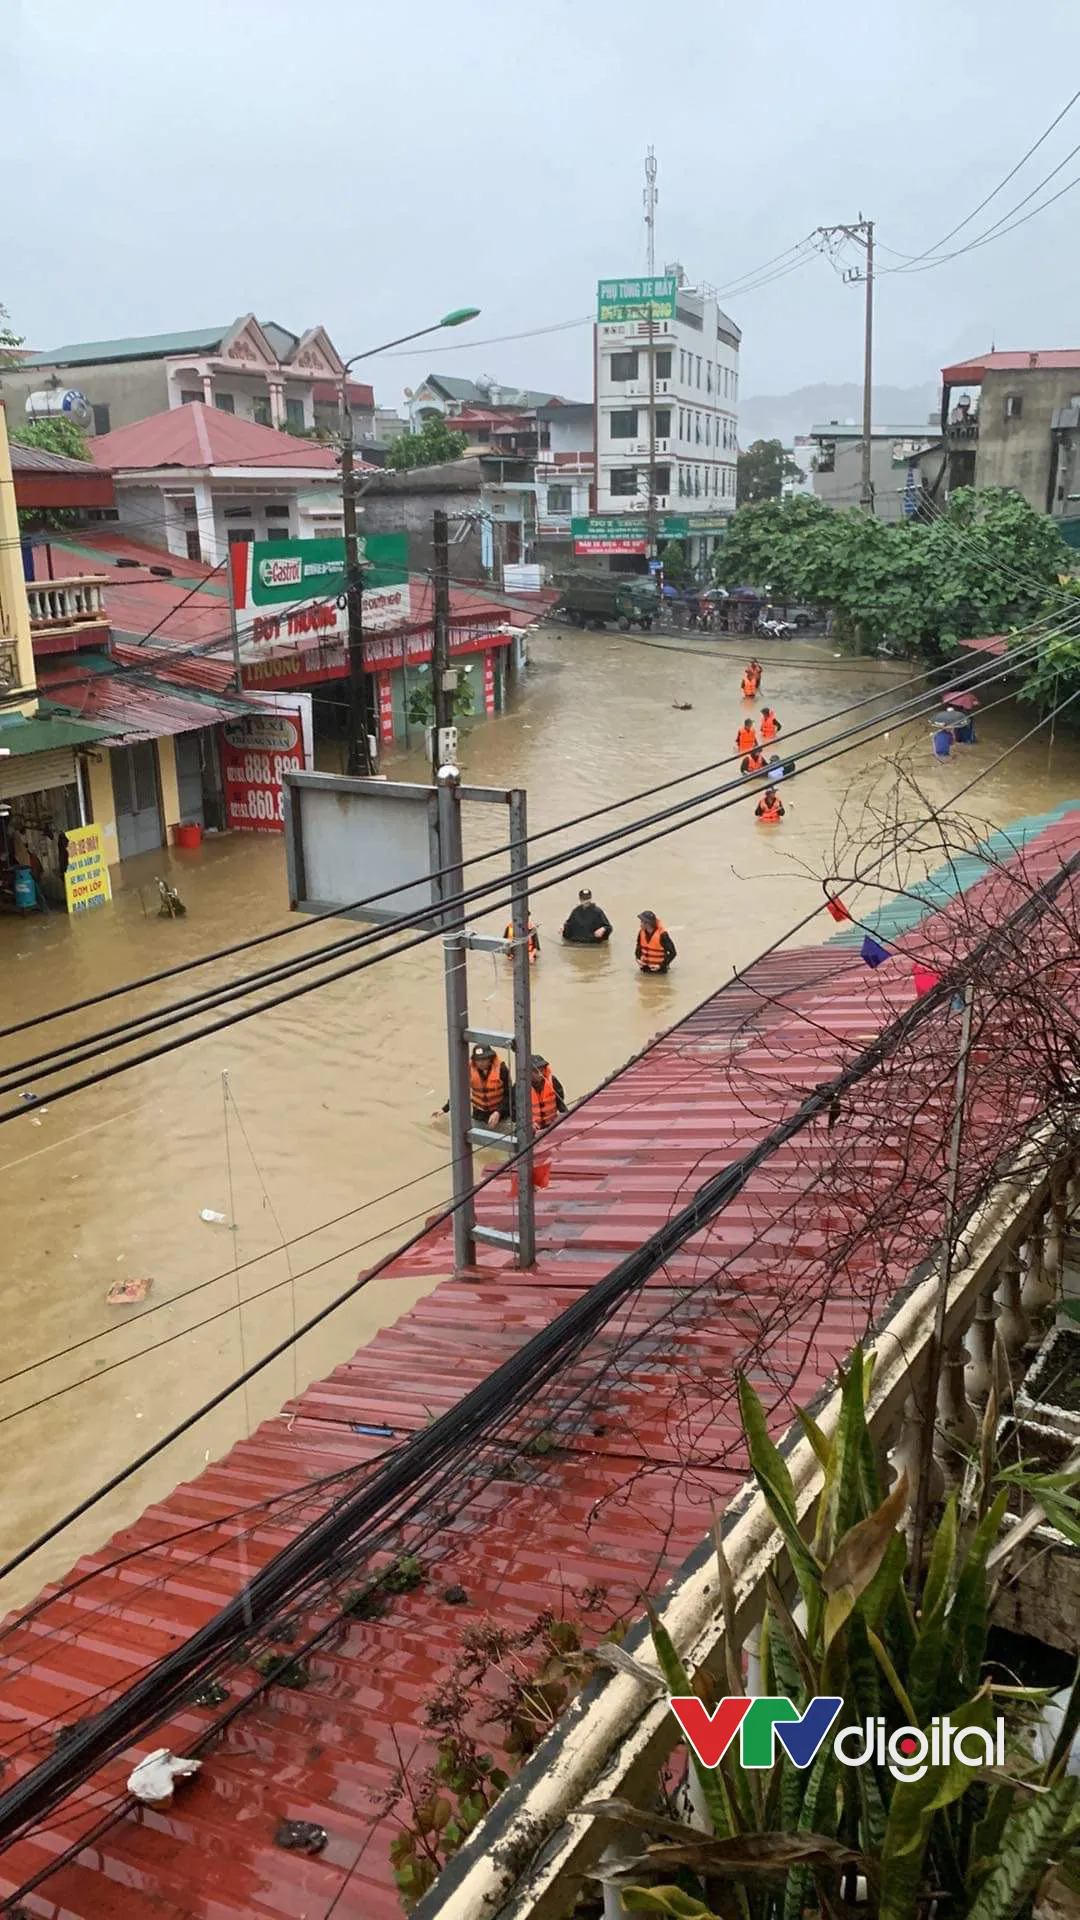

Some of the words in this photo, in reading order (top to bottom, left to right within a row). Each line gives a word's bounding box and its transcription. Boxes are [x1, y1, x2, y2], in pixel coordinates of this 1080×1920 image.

[642, 282, 653, 297] XE
[654, 280, 673, 296] MÁY
[272, 561, 300, 582] Castrol
